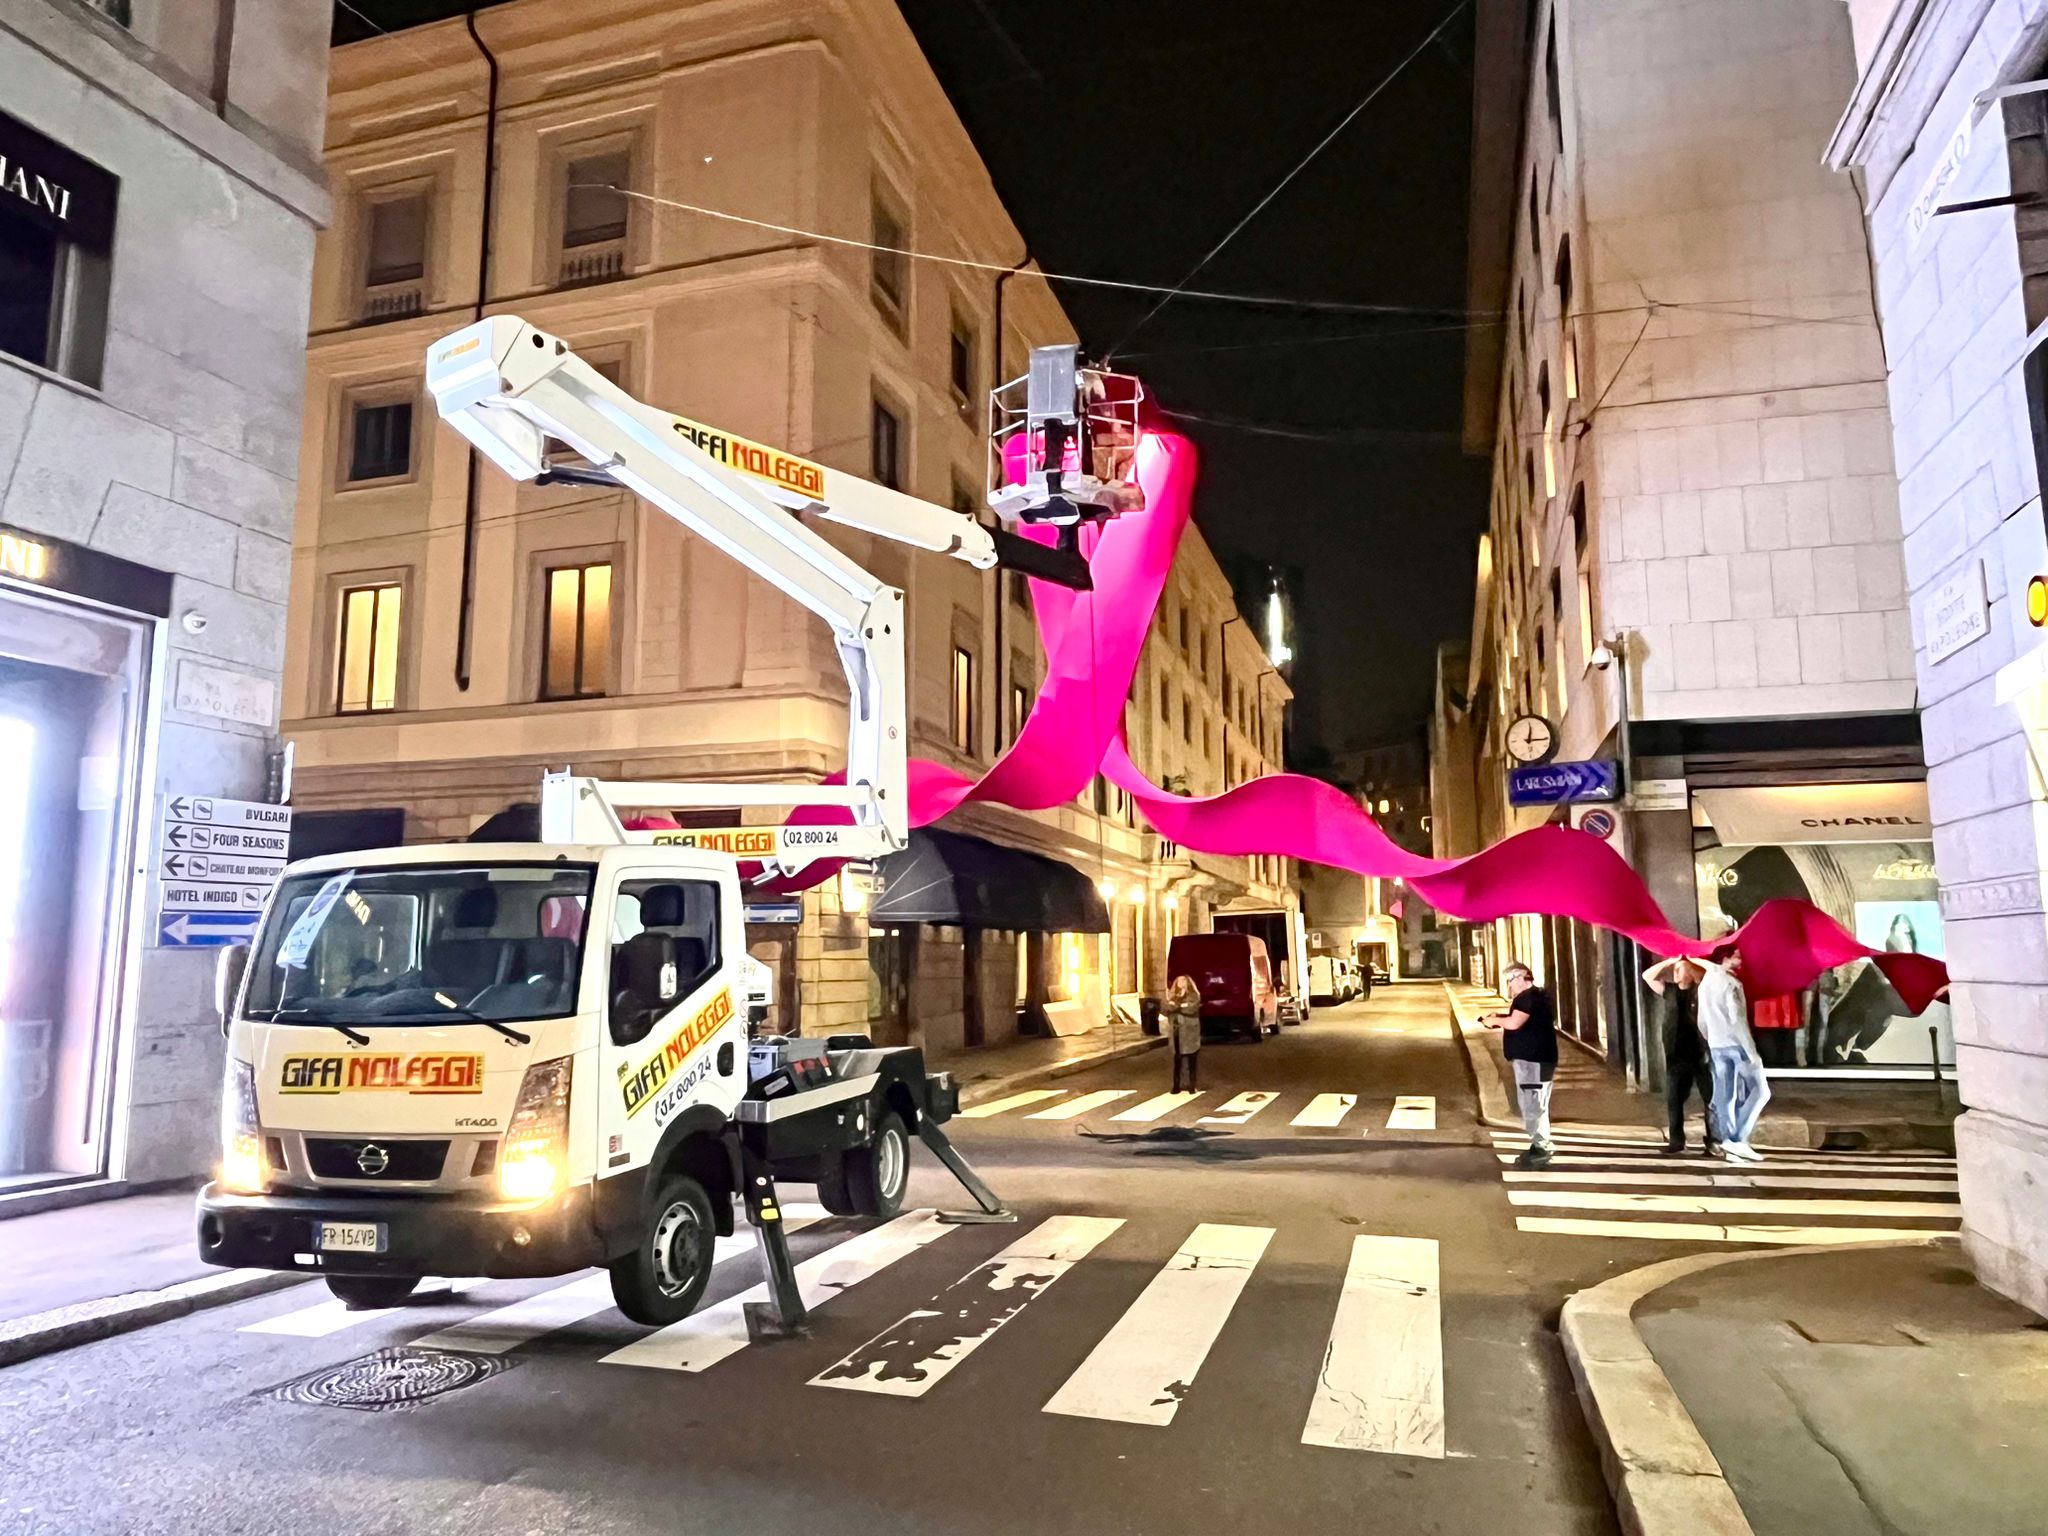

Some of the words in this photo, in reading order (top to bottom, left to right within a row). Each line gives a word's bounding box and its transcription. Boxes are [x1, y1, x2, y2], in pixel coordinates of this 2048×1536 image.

[731, 440, 820, 493] NOLEGGI
[245, 808, 289, 823] BVLGARI
[1800, 816, 1924, 829] CHANEL
[212, 833, 240, 847] FOUR
[242, 835, 285, 850] SEASONS
[167, 889, 200, 902] HOTEL
[203, 890, 238, 903] INDIGO
[622, 1053, 667, 1112] GIFFI
[665, 991, 730, 1072] NOLEGGI
[281, 1057, 343, 1087] GIFFI
[348, 1056, 475, 1087] NOLEGGI
